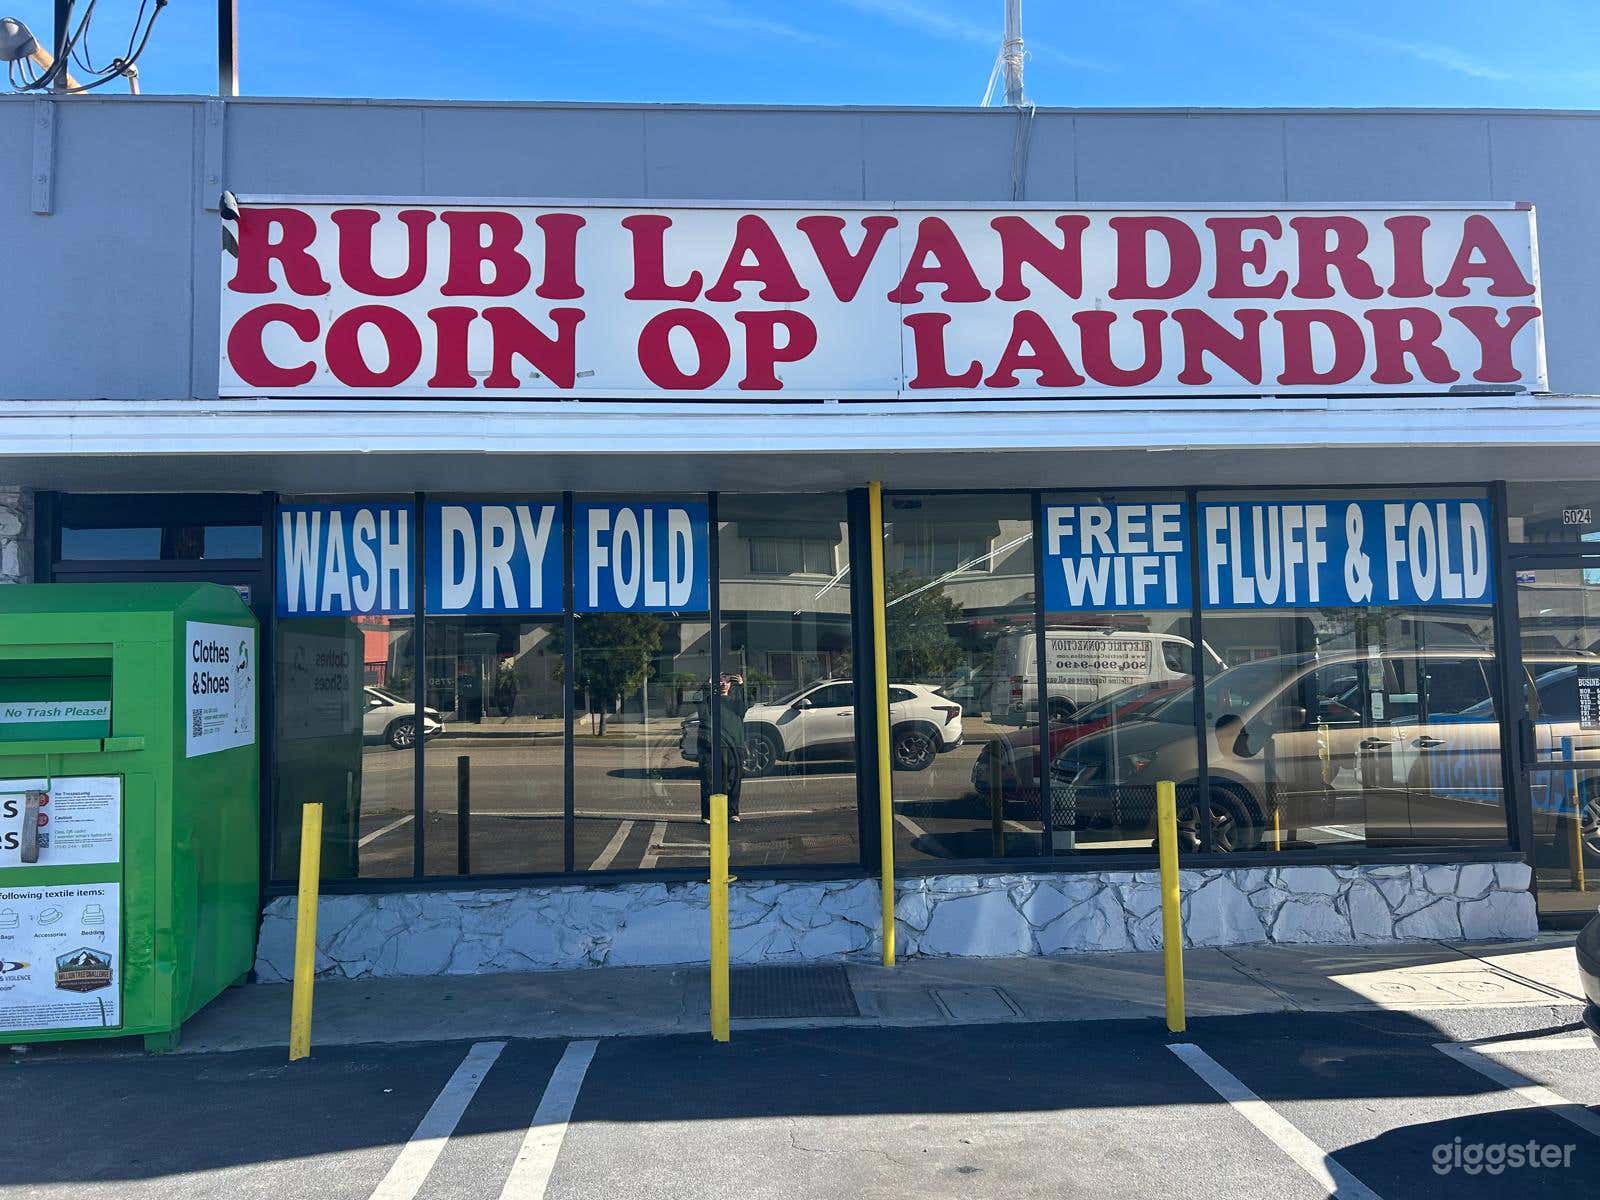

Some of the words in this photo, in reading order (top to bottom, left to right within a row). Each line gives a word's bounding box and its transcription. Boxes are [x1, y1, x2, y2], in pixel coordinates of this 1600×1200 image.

[227, 207, 586, 300] RUBI
[621, 213, 1536, 303] LAVANDERIA
[227, 303, 586, 389] COIN
[637, 308, 818, 391] OP
[902, 306, 1542, 390] LAUNDRY
[1047, 503, 1183, 556] FREE
[1563, 510, 1591, 524] 6024
[281, 508, 409, 613] WASH
[441, 505, 557, 610] DRY
[588, 507, 695, 609] FOLD
[1205, 504, 1328, 605] FLUFF
[1344, 502, 1374, 604] &
[1384, 501, 1488, 602] FOLD
[1062, 554, 1178, 607] WIFI
[192, 640, 230, 664] Clothes
[193, 672, 200, 695] &
[201, 672, 230, 695] Shoes
[1578, 678, 1600, 687] BUSINE
[5, 708, 22, 718] No
[26, 707, 61, 717] Trash
[65, 706, 107, 717] Please!
[45, 889, 74, 898] textile
[76, 889, 105, 897] items:
